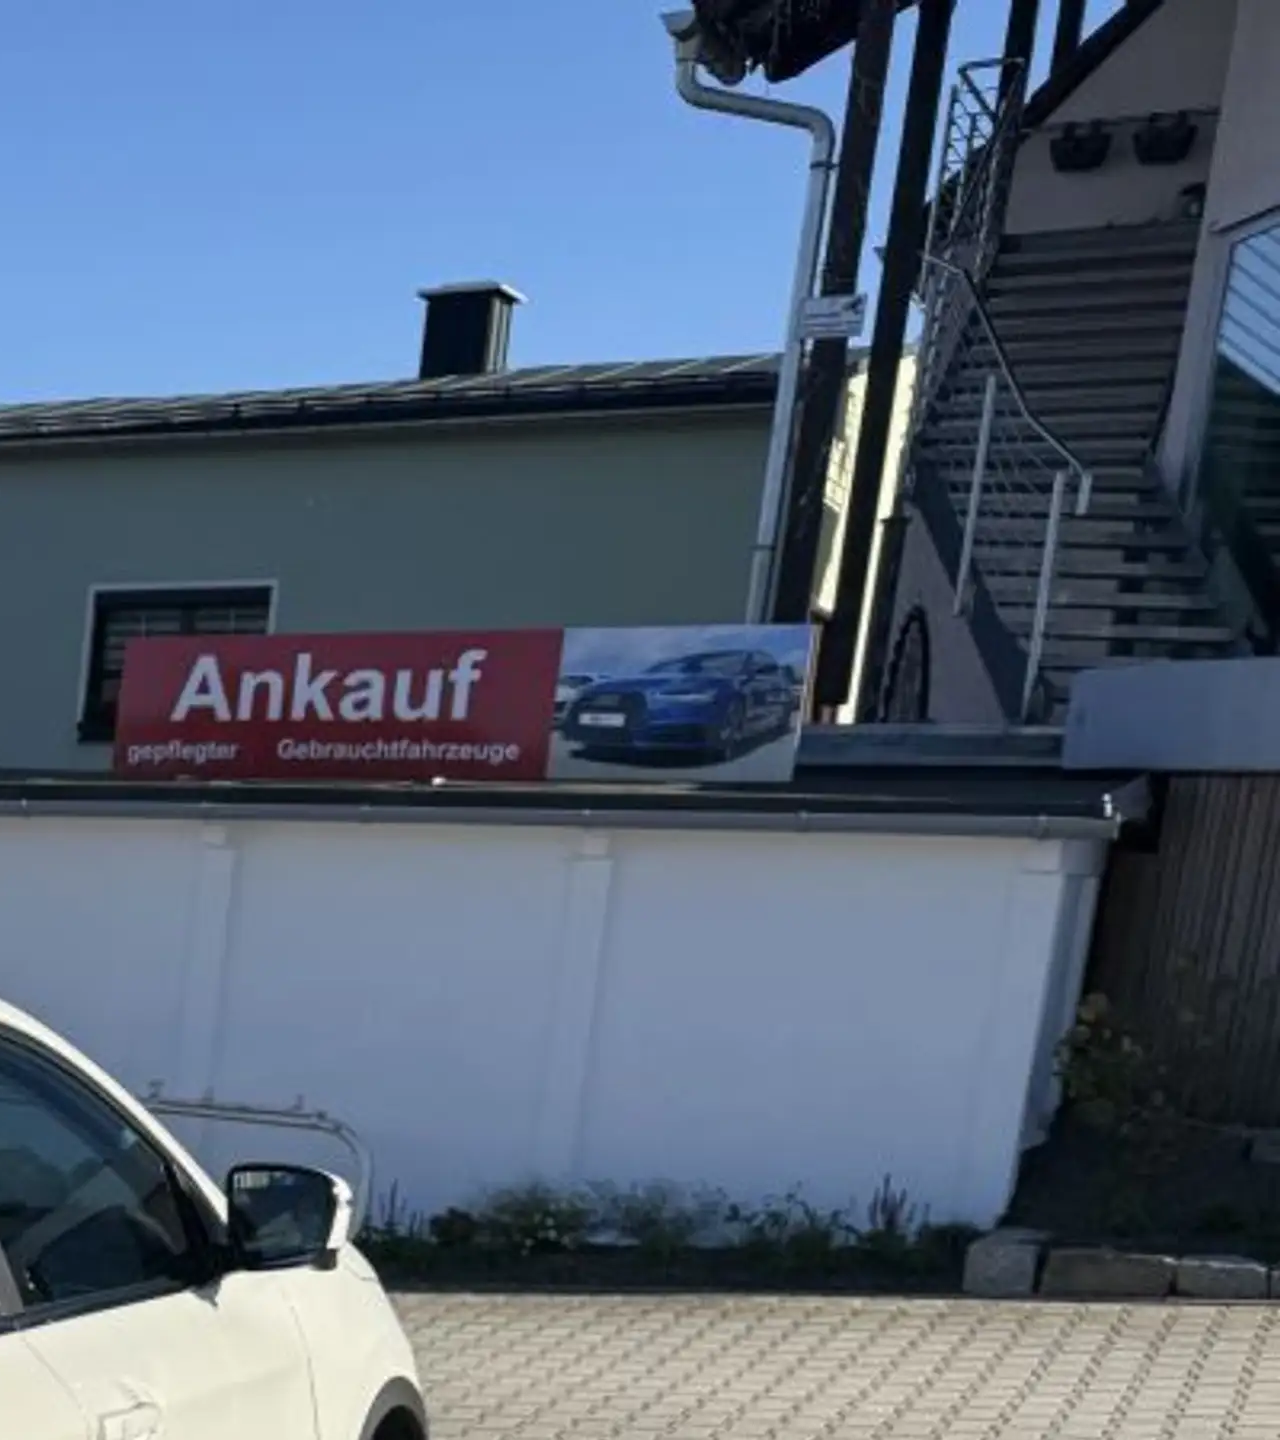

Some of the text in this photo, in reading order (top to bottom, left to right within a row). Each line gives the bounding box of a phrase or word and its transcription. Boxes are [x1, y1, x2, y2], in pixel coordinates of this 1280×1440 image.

[170, 648, 488, 723] Ankauf
[127, 738, 521, 767] gepflegter Gebrauchtfahrzeuge
